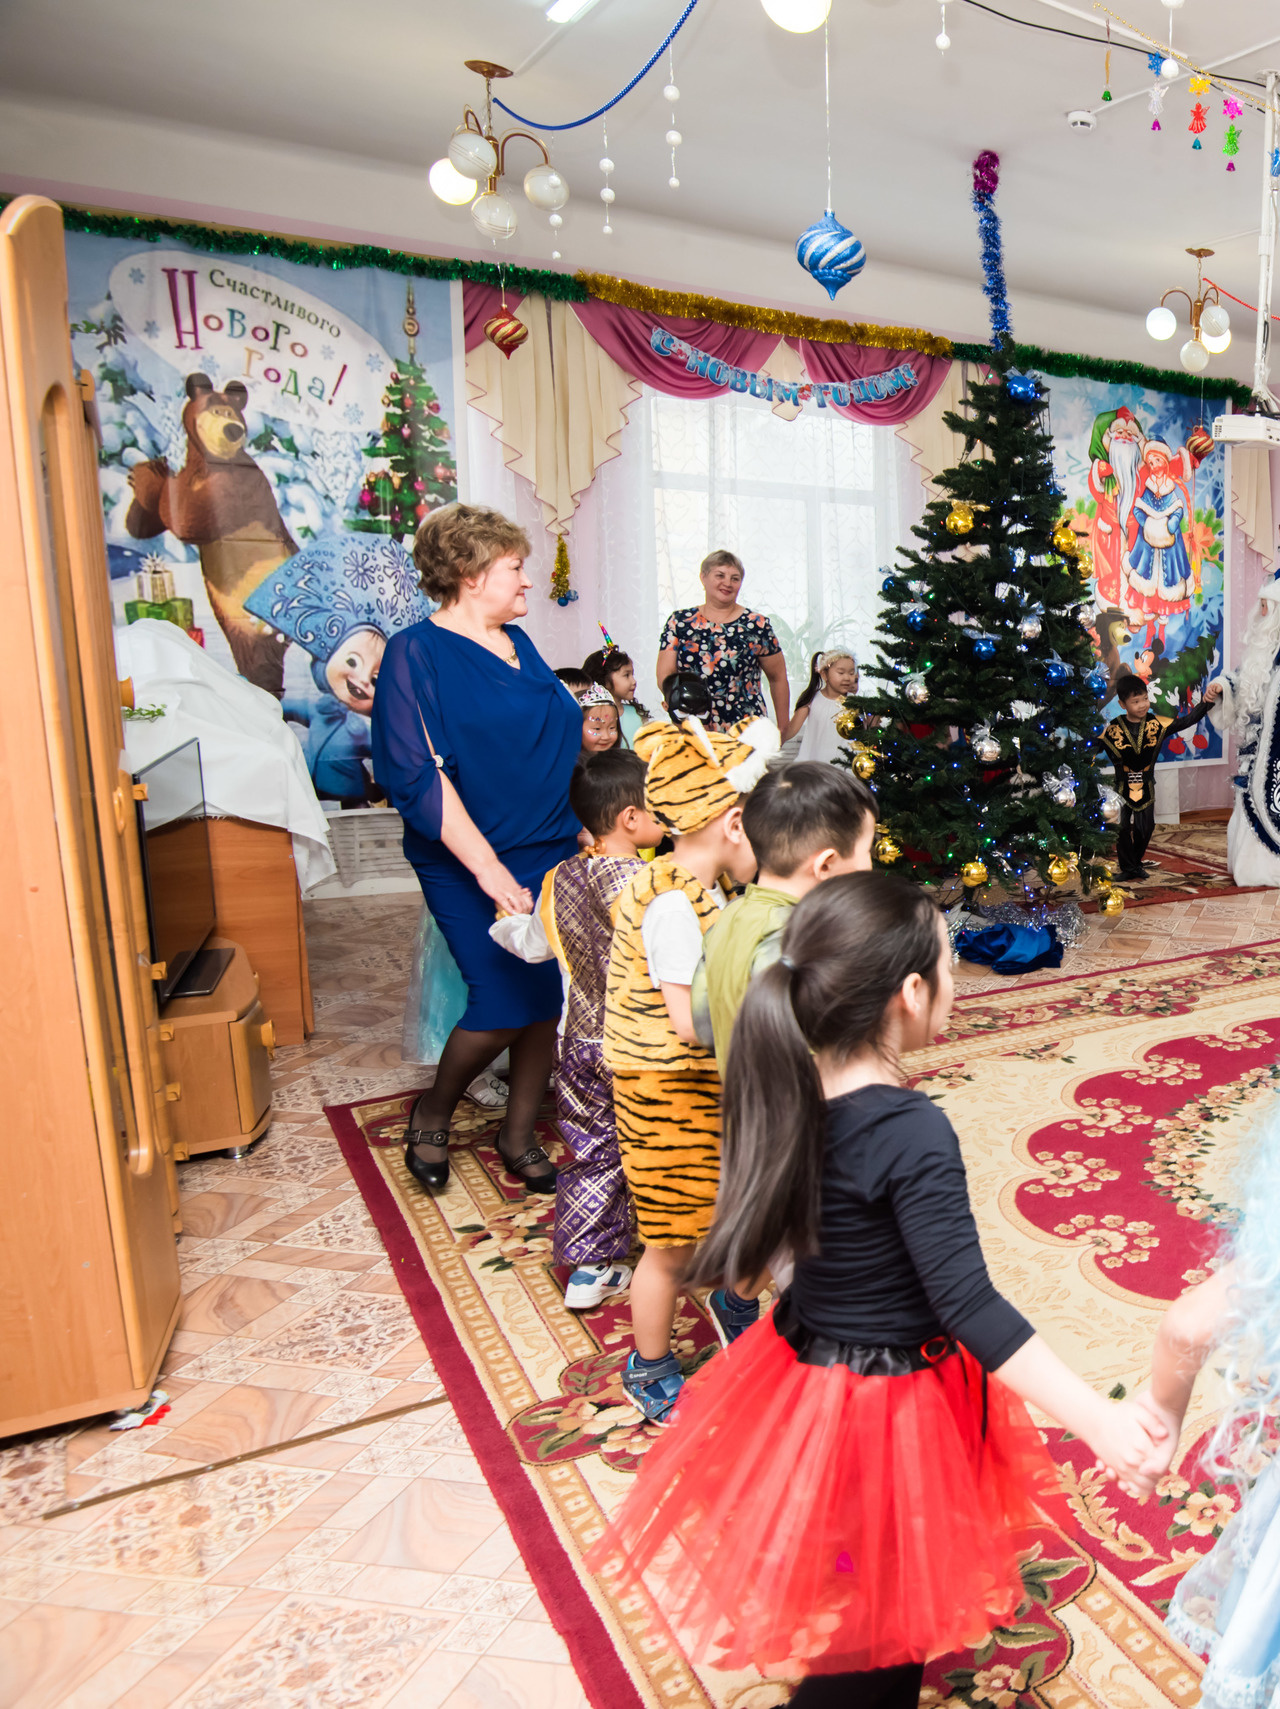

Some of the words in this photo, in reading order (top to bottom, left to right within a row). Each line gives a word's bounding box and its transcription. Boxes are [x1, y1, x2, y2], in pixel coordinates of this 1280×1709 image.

[209, 268, 341, 338] Счастливого
[651, 326, 675, 356] С
[686, 347, 800, 407] НОВЫМ
[812, 363, 918, 408] ГОДОМ!
